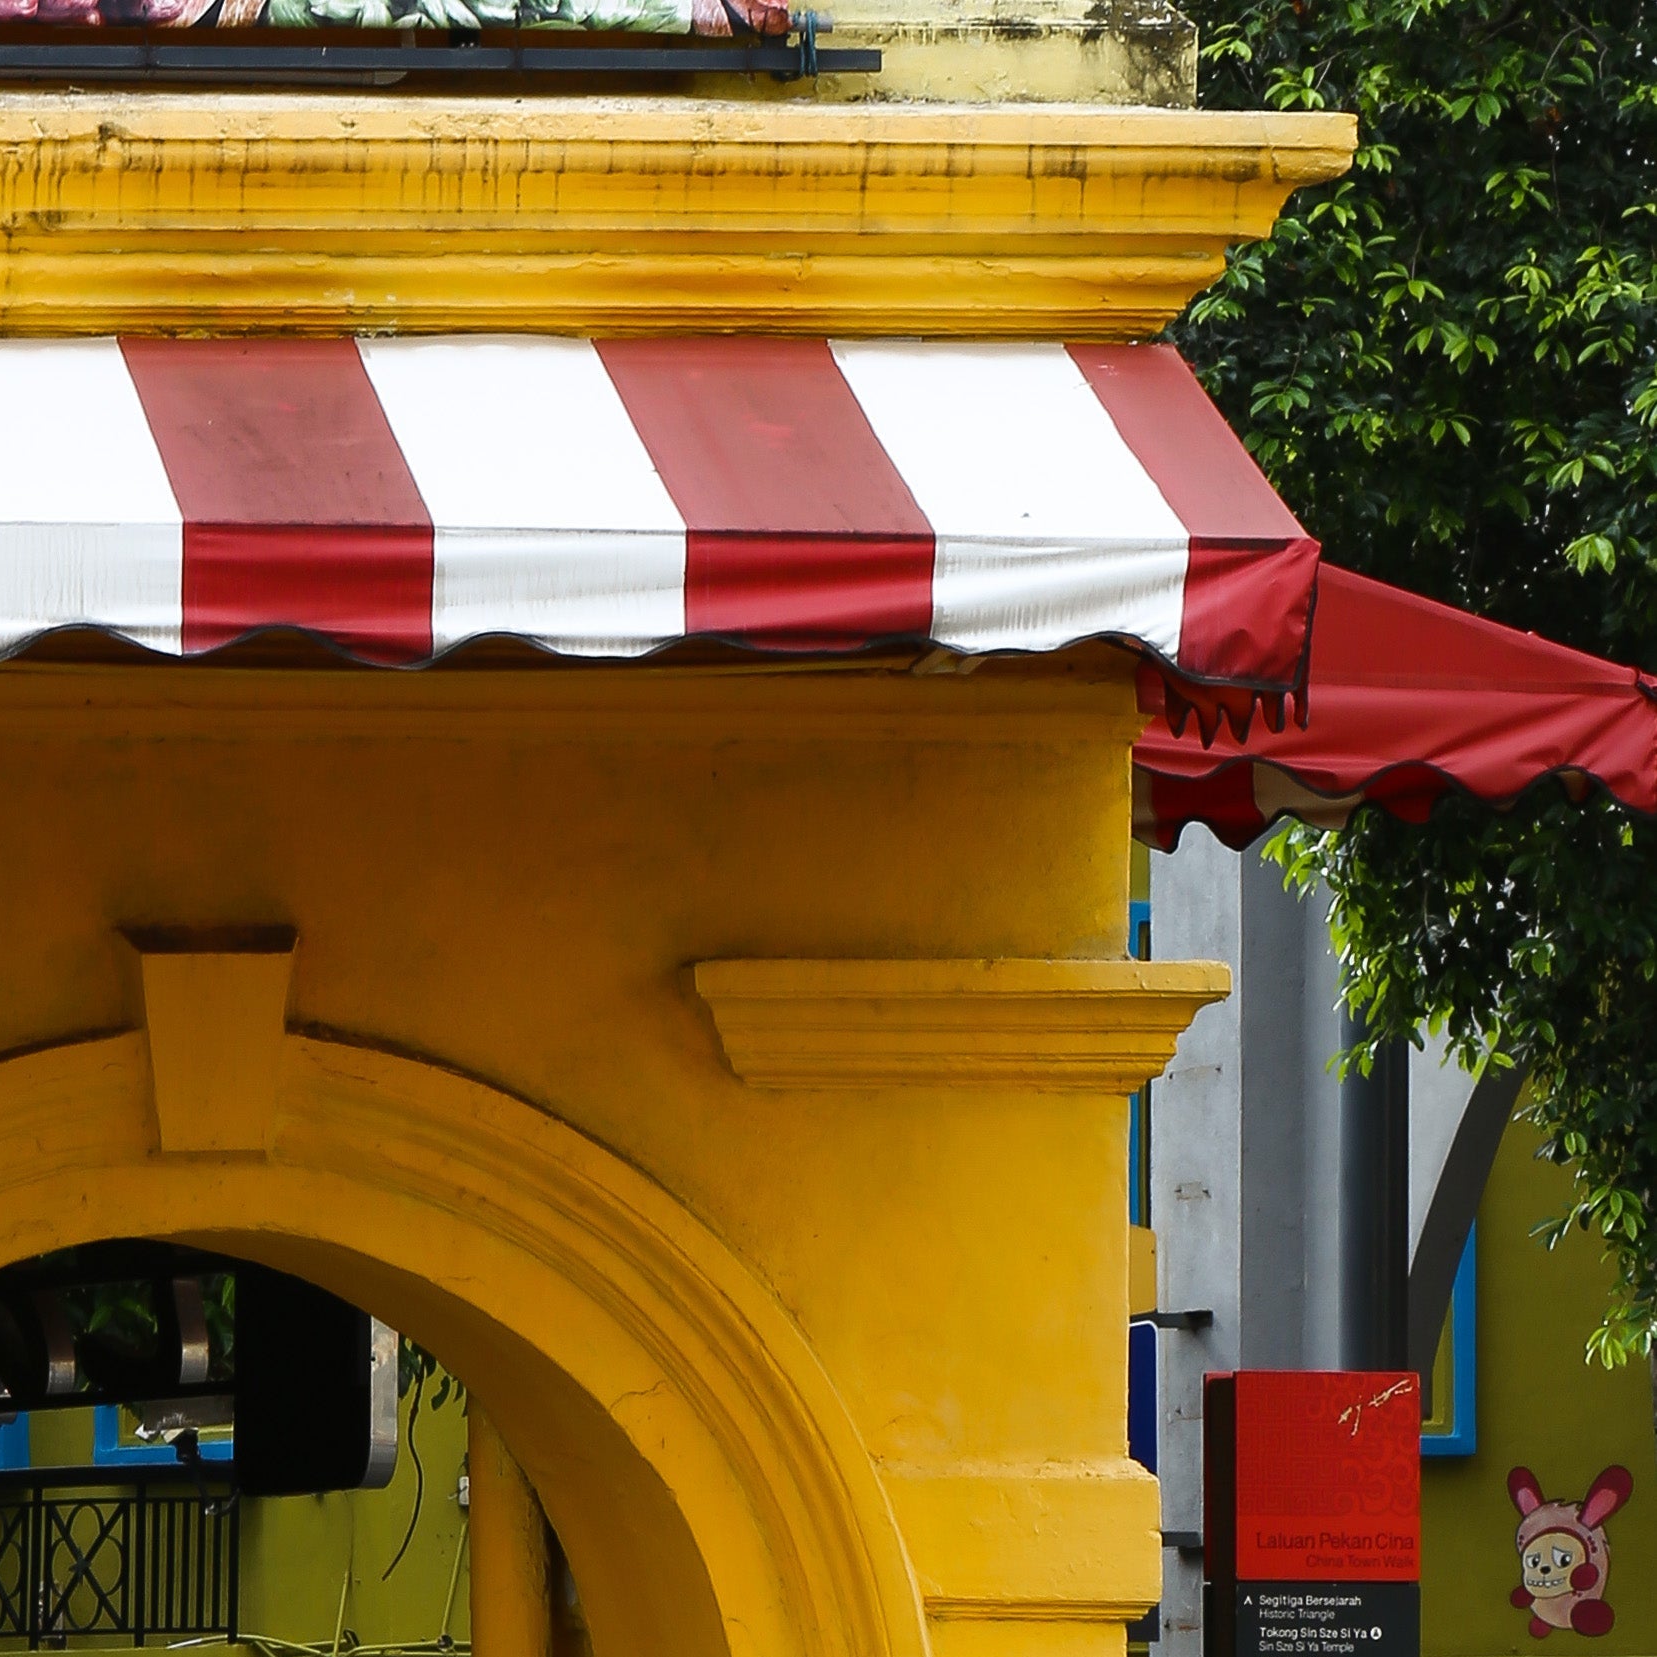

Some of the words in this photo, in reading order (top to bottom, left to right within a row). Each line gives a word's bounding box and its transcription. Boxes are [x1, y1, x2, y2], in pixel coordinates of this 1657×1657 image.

[1256, 1532, 1316, 1550] Laluan
[1319, 1532, 1372, 1550] Pekan
[1375, 1532, 1415, 1550] Cina
[1306, 1554, 1344, 1568] China
[1347, 1554, 1382, 1568] Town
[1383, 1554, 1415, 1568] Walk
[1259, 1594, 1303, 1609] Segitiga
[1305, 1595, 1362, 1607] Bersejarah
[1259, 1609, 1295, 1619] Historic
[1298, 1609, 1336, 1621] Triangle
[1259, 1627, 1298, 1640] Tokong
[1299, 1627, 1318, 1639] Sin
[1319, 1627, 1339, 1639] Sze
[1340, 1627, 1351, 1639] Si
[1353, 1627, 1368, 1639] Ya
[1258, 1642, 1274, 1652] Sin
[1275, 1642, 1294, 1652] Sze
[1295, 1642, 1306, 1652] Si
[1307, 1642, 1319, 1652] Ya
[1322, 1642, 1355, 1654] Temple
